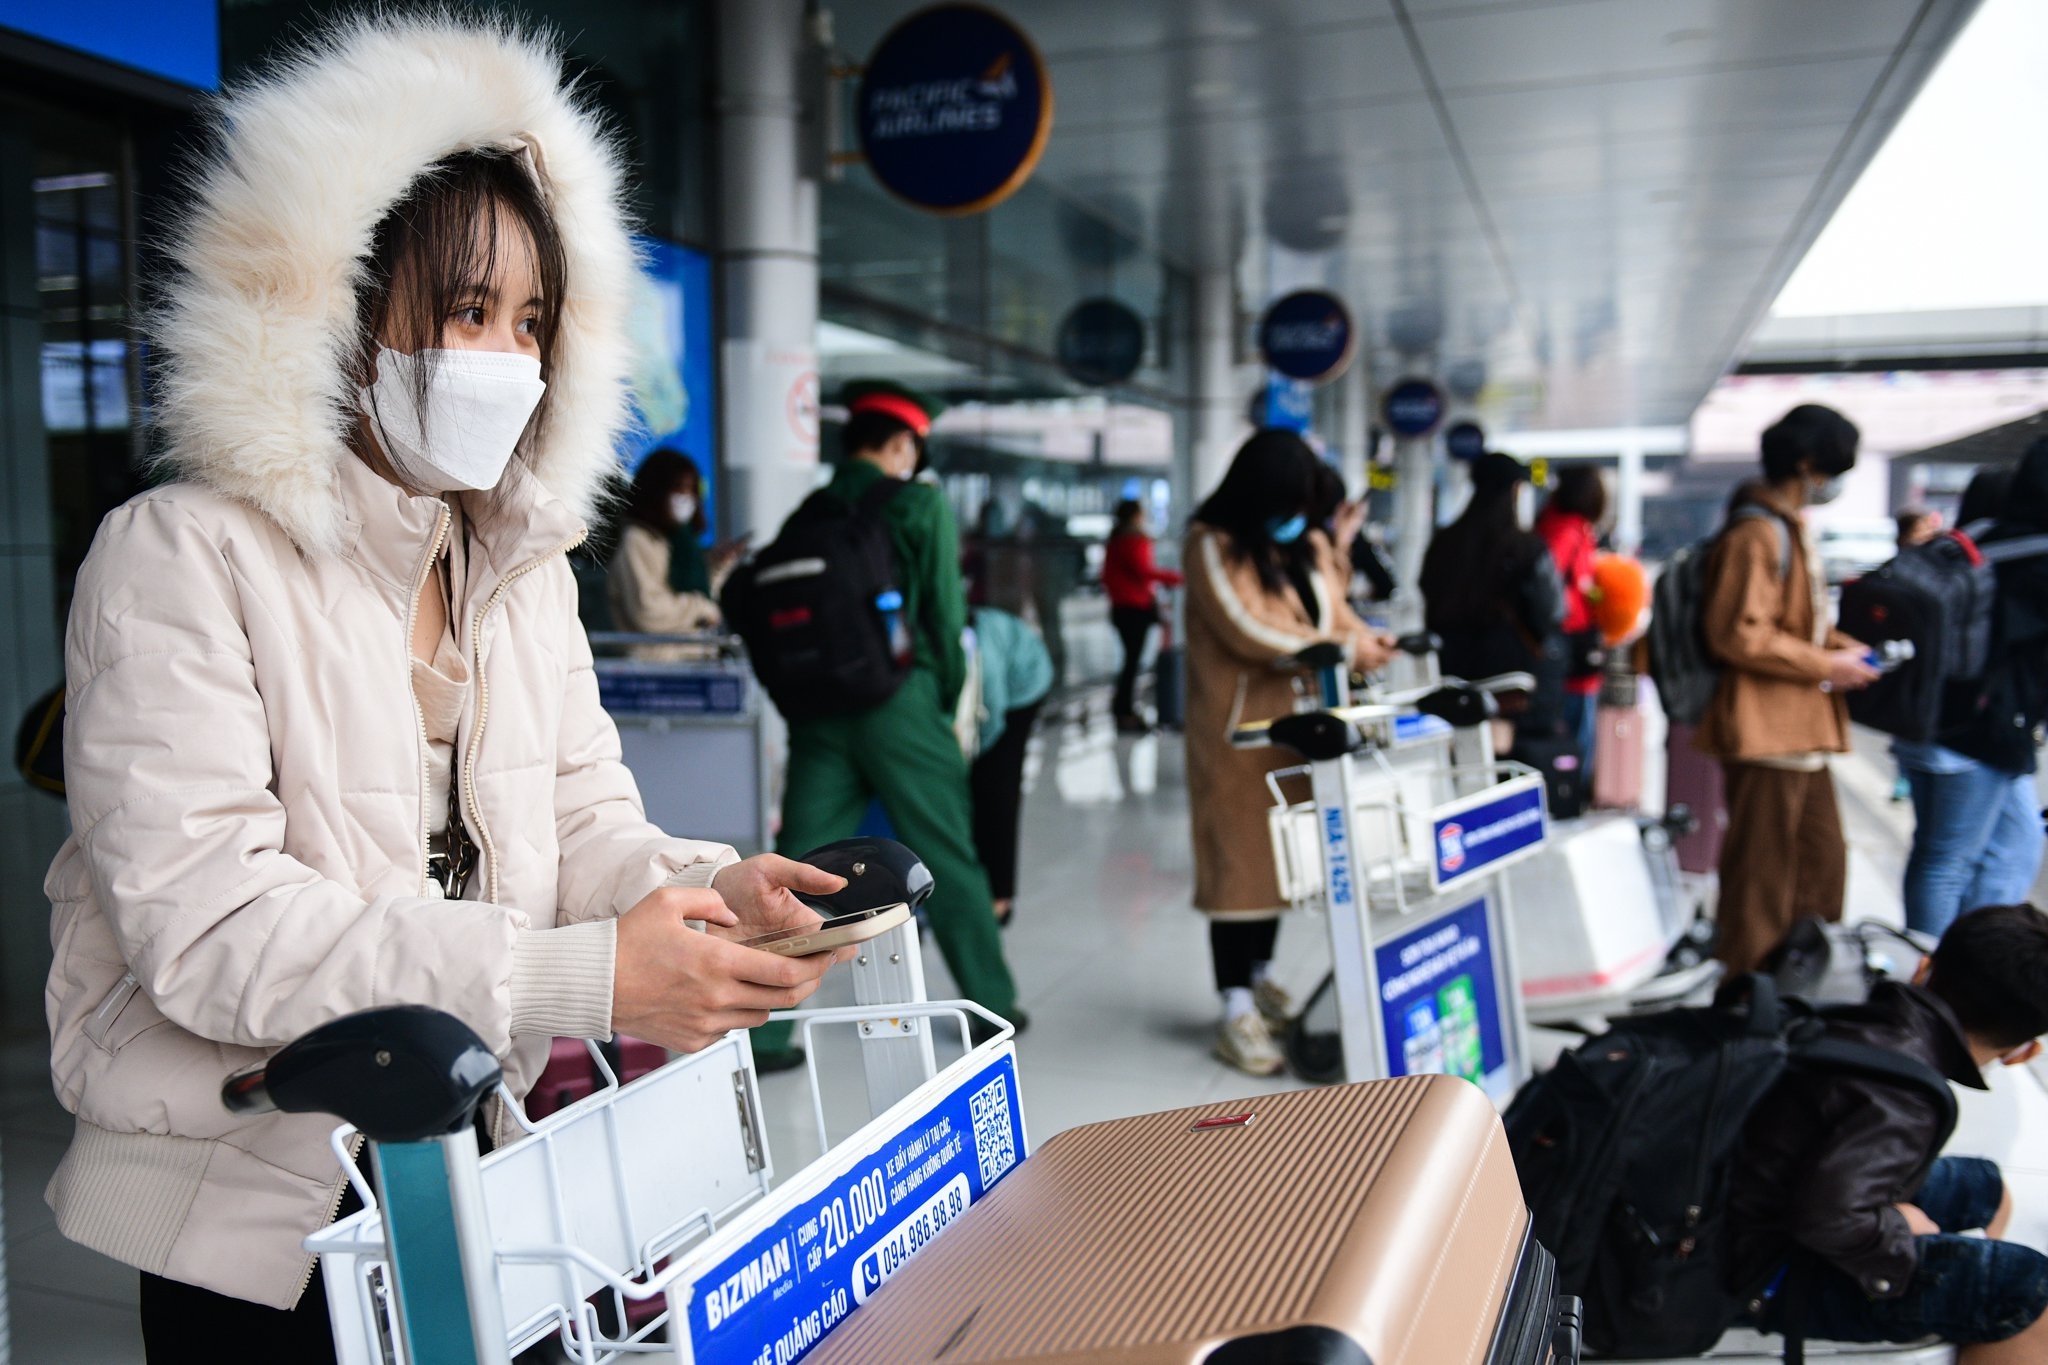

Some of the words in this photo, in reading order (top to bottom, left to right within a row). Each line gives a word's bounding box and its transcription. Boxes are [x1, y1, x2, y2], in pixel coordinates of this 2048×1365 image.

[869, 79, 973, 110] PACIFIC
[872, 103, 1001, 137] AIRLINES
[885, 1158, 896, 1179] XE
[907, 1137, 924, 1163] HÀNH
[922, 1129, 930, 1151] LÝ
[940, 1116, 951, 1138] CÁC
[906, 1168, 923, 1193] HÀNG
[922, 1152, 941, 1180] KHÔNG
[953, 1130, 962, 1153] TẾ
[797, 1217, 819, 1247] CUNG
[820, 1168, 887, 1259] 20.000
[883, 1186, 963, 1275] 094.986.98.98
[704, 1237, 791, 1332] BIZMAN
[807, 1242, 822, 1272] CẤP
[773, 1279, 793, 1301] Media
[775, 1310, 821, 1365] QUẢNG
[821, 1287, 848, 1330] CÁO
